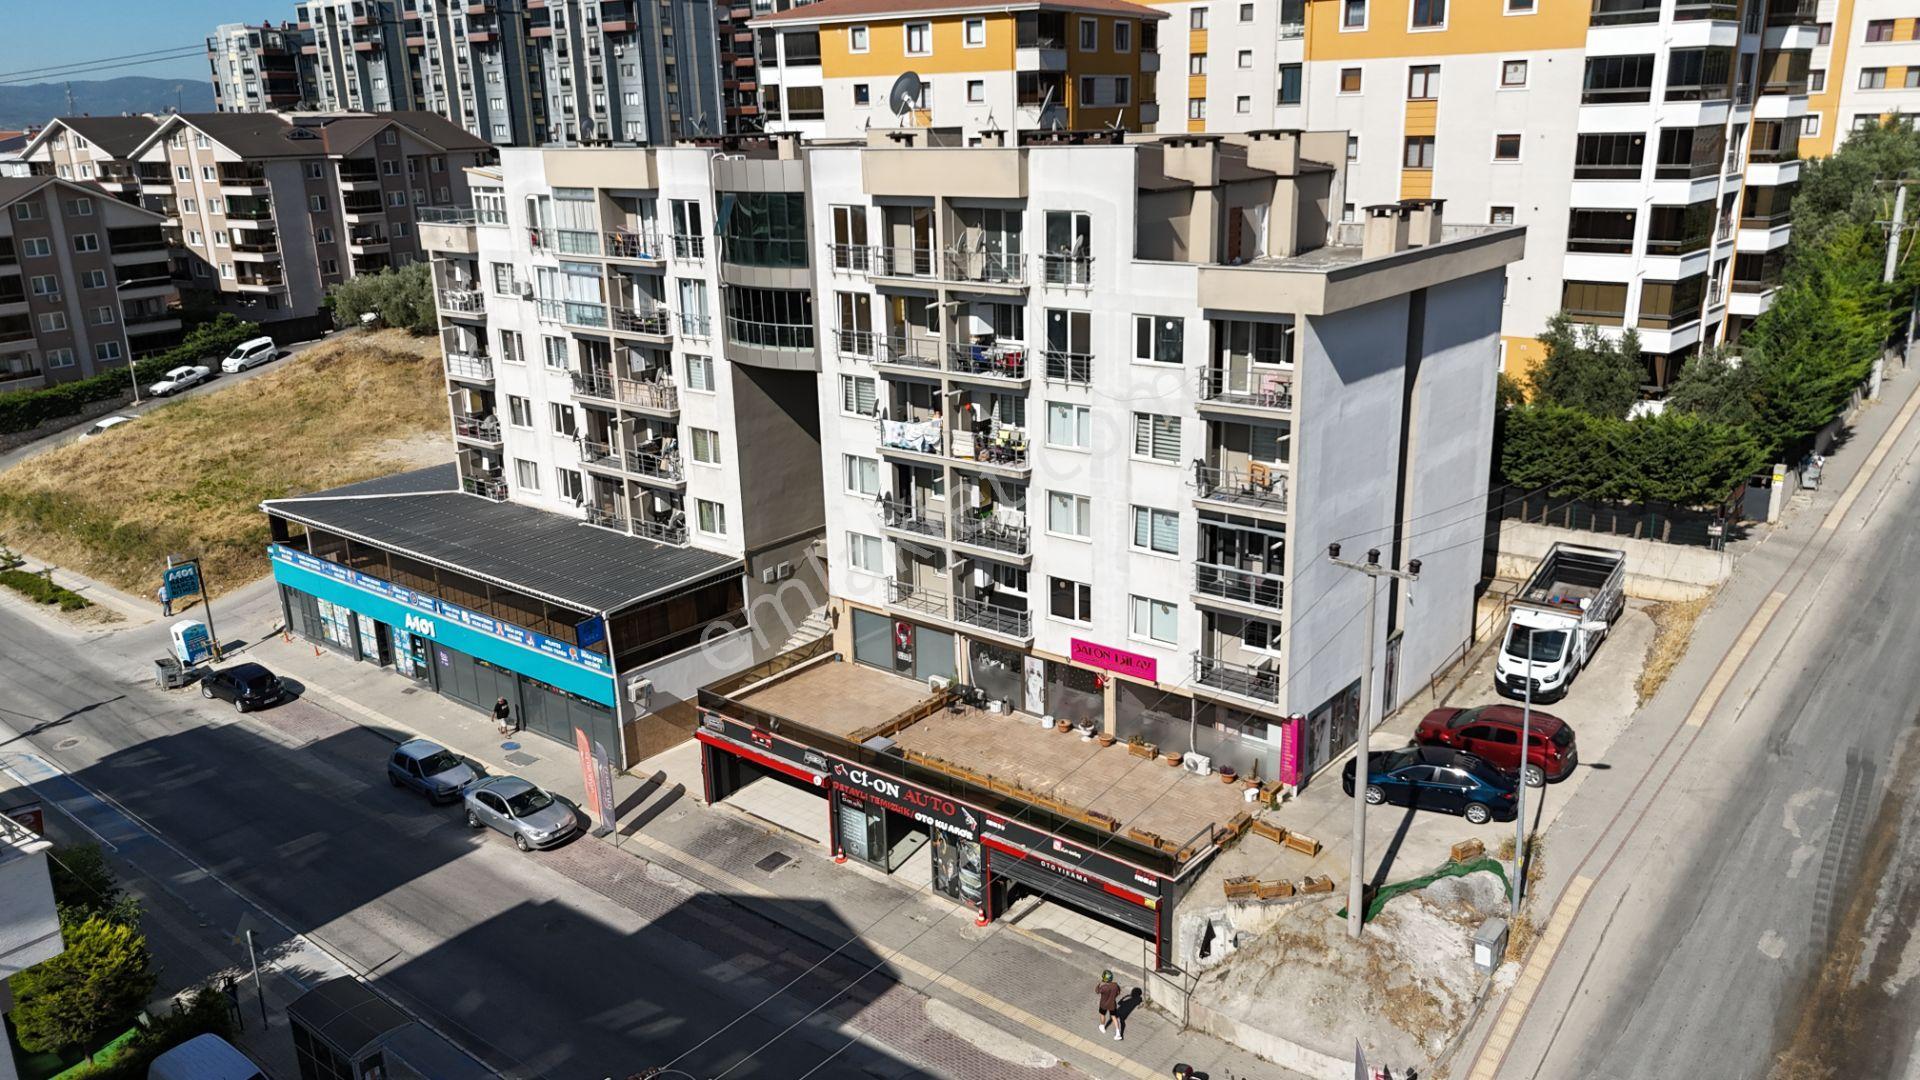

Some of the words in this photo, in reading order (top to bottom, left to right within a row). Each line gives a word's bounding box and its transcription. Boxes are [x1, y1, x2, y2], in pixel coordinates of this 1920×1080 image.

[405, 612, 437, 638] A101
[903, 789, 956, 816] AUTO
[1040, 860, 1056, 871] OTO
